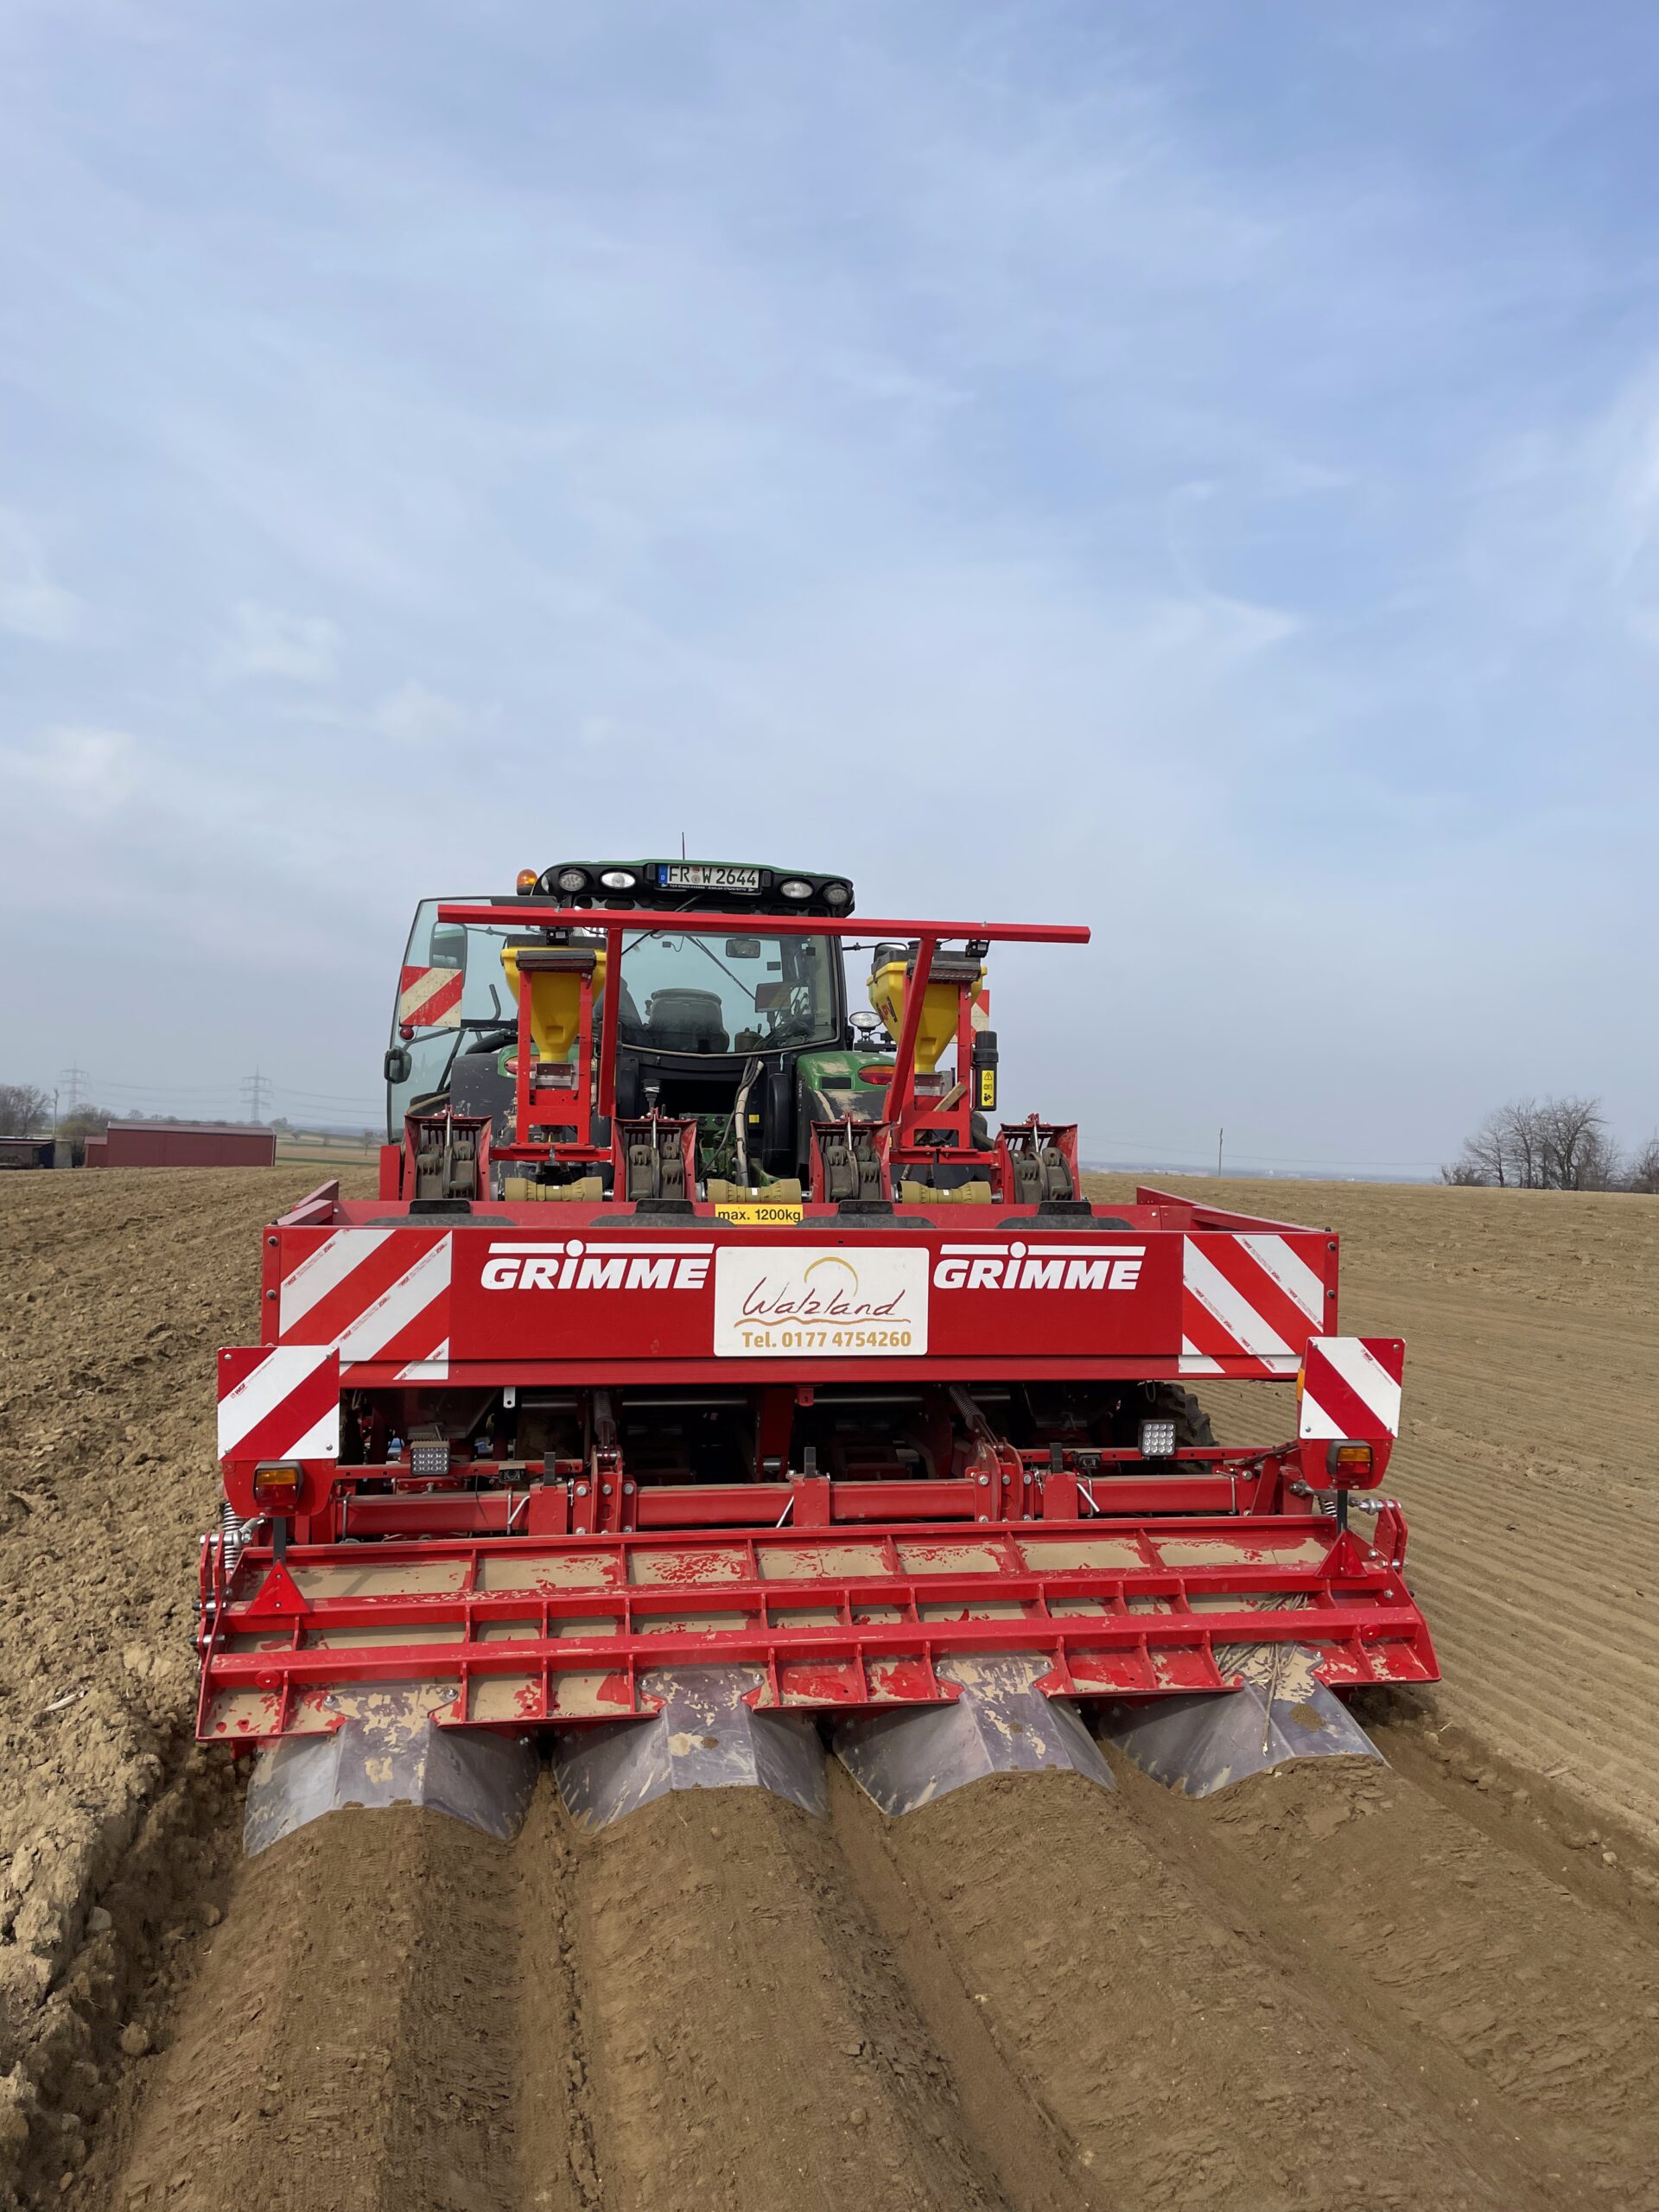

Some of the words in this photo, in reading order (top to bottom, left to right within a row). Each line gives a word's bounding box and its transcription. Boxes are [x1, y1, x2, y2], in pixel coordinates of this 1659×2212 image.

[669, 866, 690, 882] FR
[702, 867, 712, 883] W
[716, 868, 756, 886] 2644
[718, 1211, 750, 1220] max.
[754, 1209, 801, 1222] 1200kg
[742, 1276, 906, 1316] Walzland
[741, 1332, 778, 1348] Tel.
[782, 1332, 827, 1348] 0177
[832, 1332, 912, 1348] 4754260
